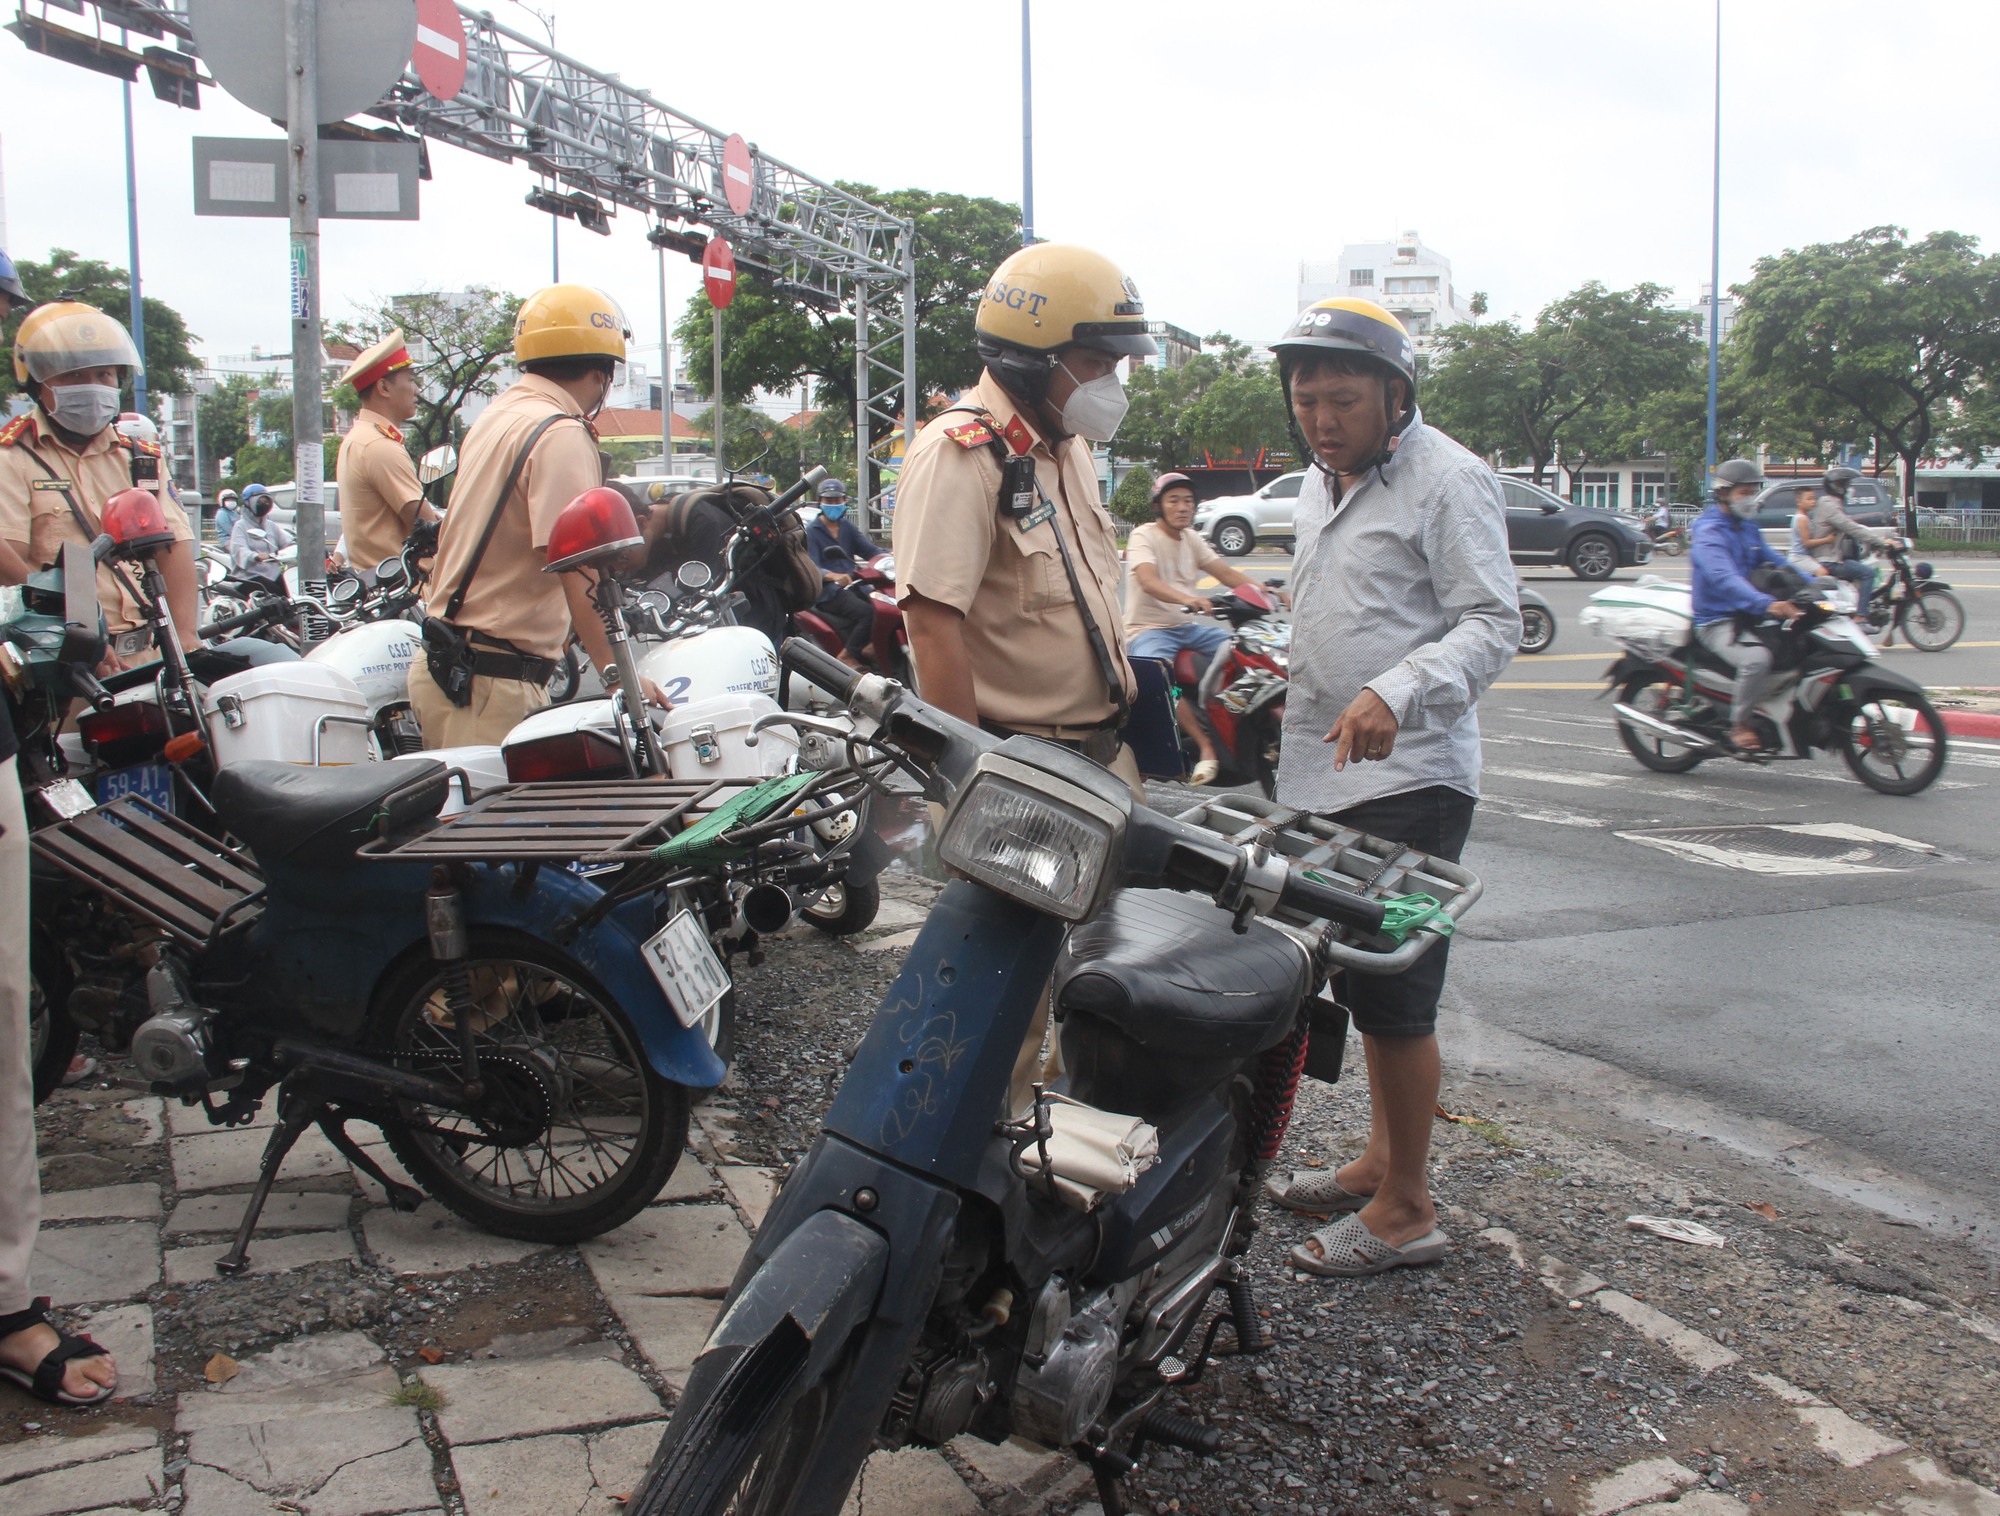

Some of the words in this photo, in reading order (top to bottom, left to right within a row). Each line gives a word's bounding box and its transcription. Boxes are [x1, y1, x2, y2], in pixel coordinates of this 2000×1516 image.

[985, 280, 1048, 316] CSGT
[590, 312, 624, 331] CSG
[1299, 311, 1332, 327] be
[1916, 457, 1948, 469] 213
[362, 664, 393, 675] TRAFFIC
[664, 676, 692, 704] 2
[726, 682, 752, 693] TRAFFIC
[753, 679, 769, 691] POLICE
[107, 764, 160, 801] 59-A1
